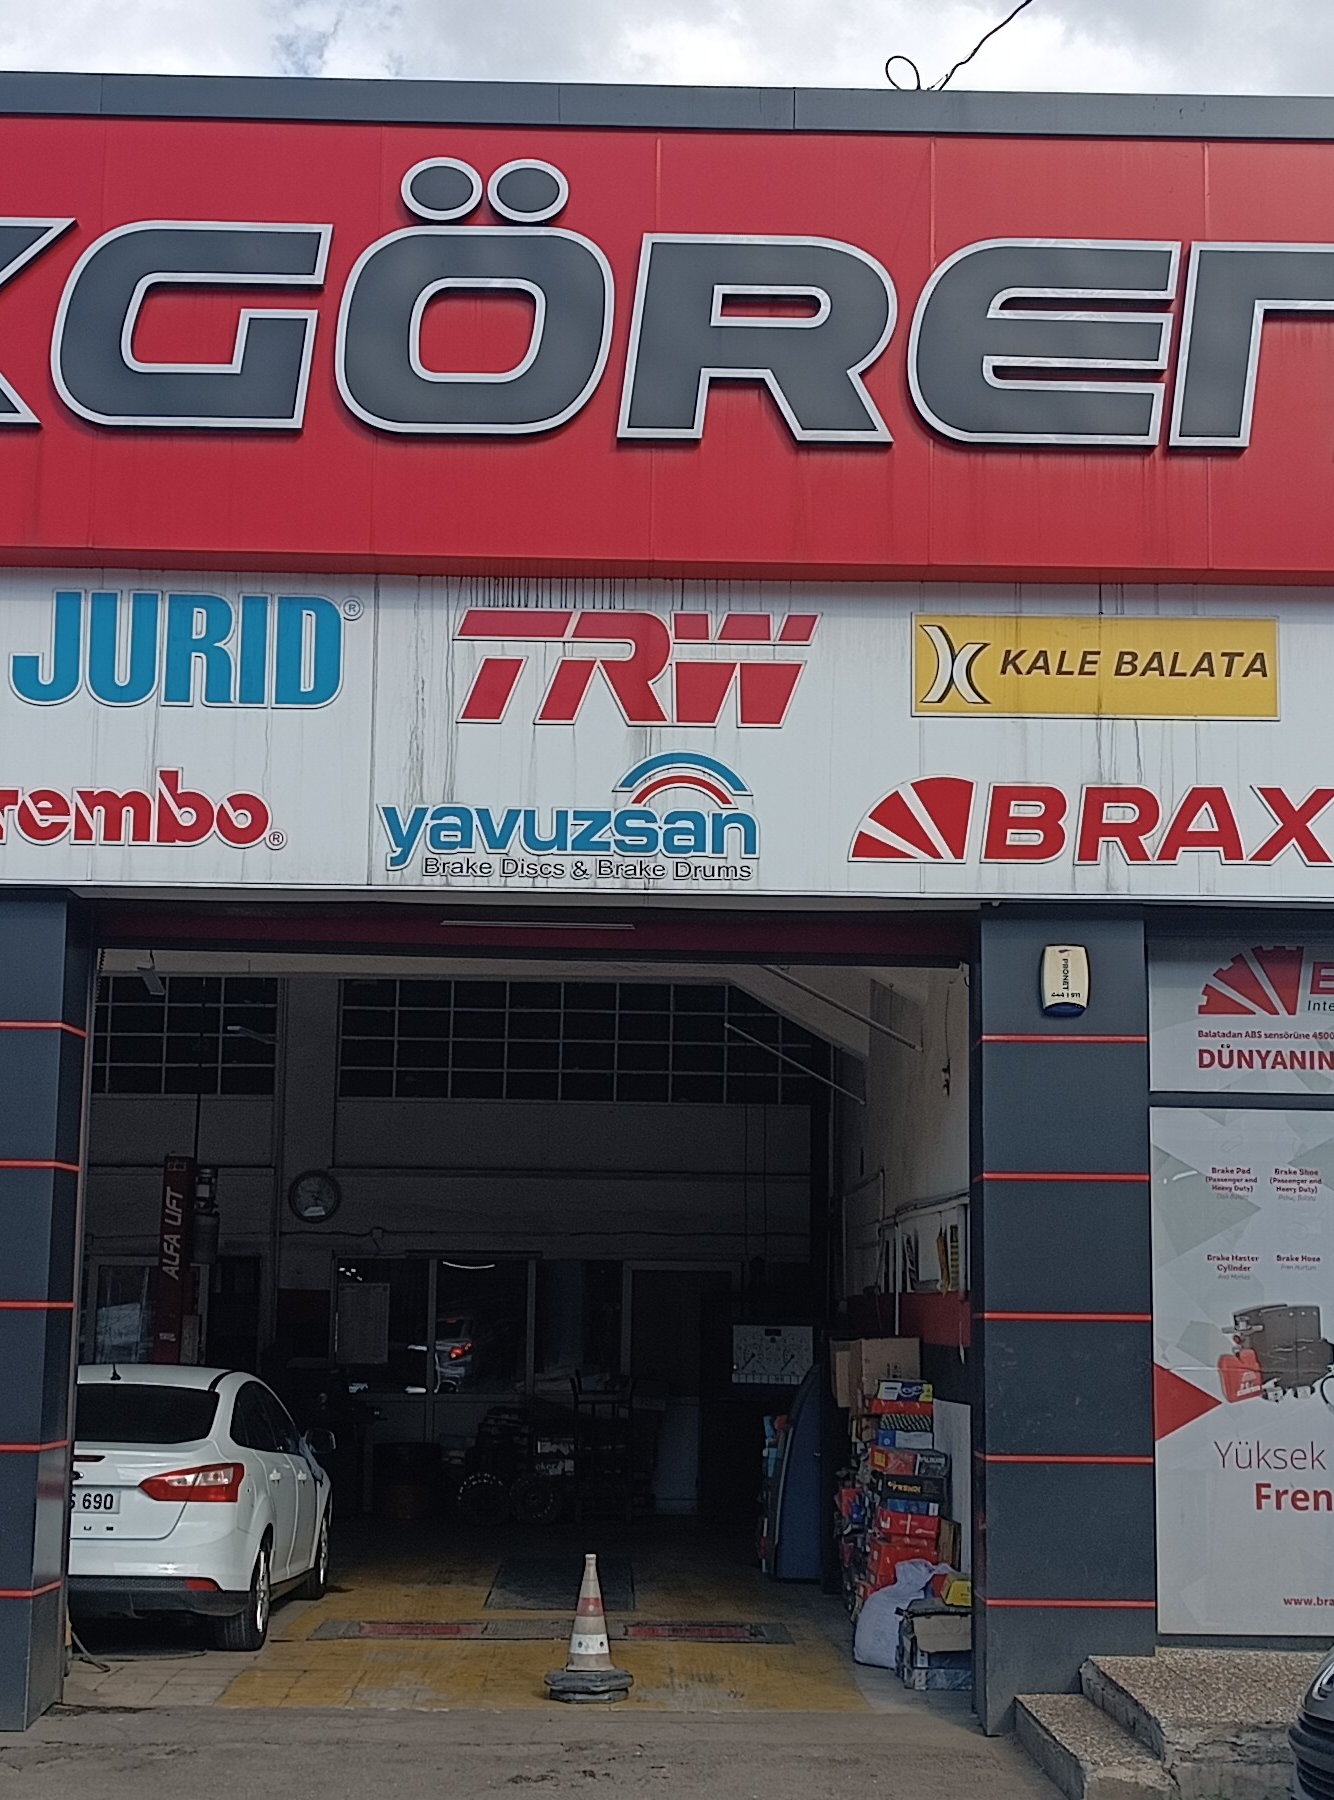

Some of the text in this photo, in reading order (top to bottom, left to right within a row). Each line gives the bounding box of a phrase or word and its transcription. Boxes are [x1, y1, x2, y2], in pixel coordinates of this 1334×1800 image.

[12, 589, 343, 708] JURID
[999, 647, 1270, 679] KALE BALATA
[453, 609, 822, 728] TRW
[381, 805, 758, 866] yavuzsan
[424, 857, 752, 880] Brake Discs & Brake Drums
[1197, 1030, 1242, 1039] Balatadan
[1245, 1031, 1262, 1039] ABS
[1264, 1031, 1310, 1040] sensörüne
[165, 1186, 184, 1227] LIFT
[162, 1234, 181, 1281] ALFA
[1213, 1440, 1327, 1471] Yüksek
[82, 1493, 114, 1510] 690
[1254, 1482, 1334, 1512] Fren
